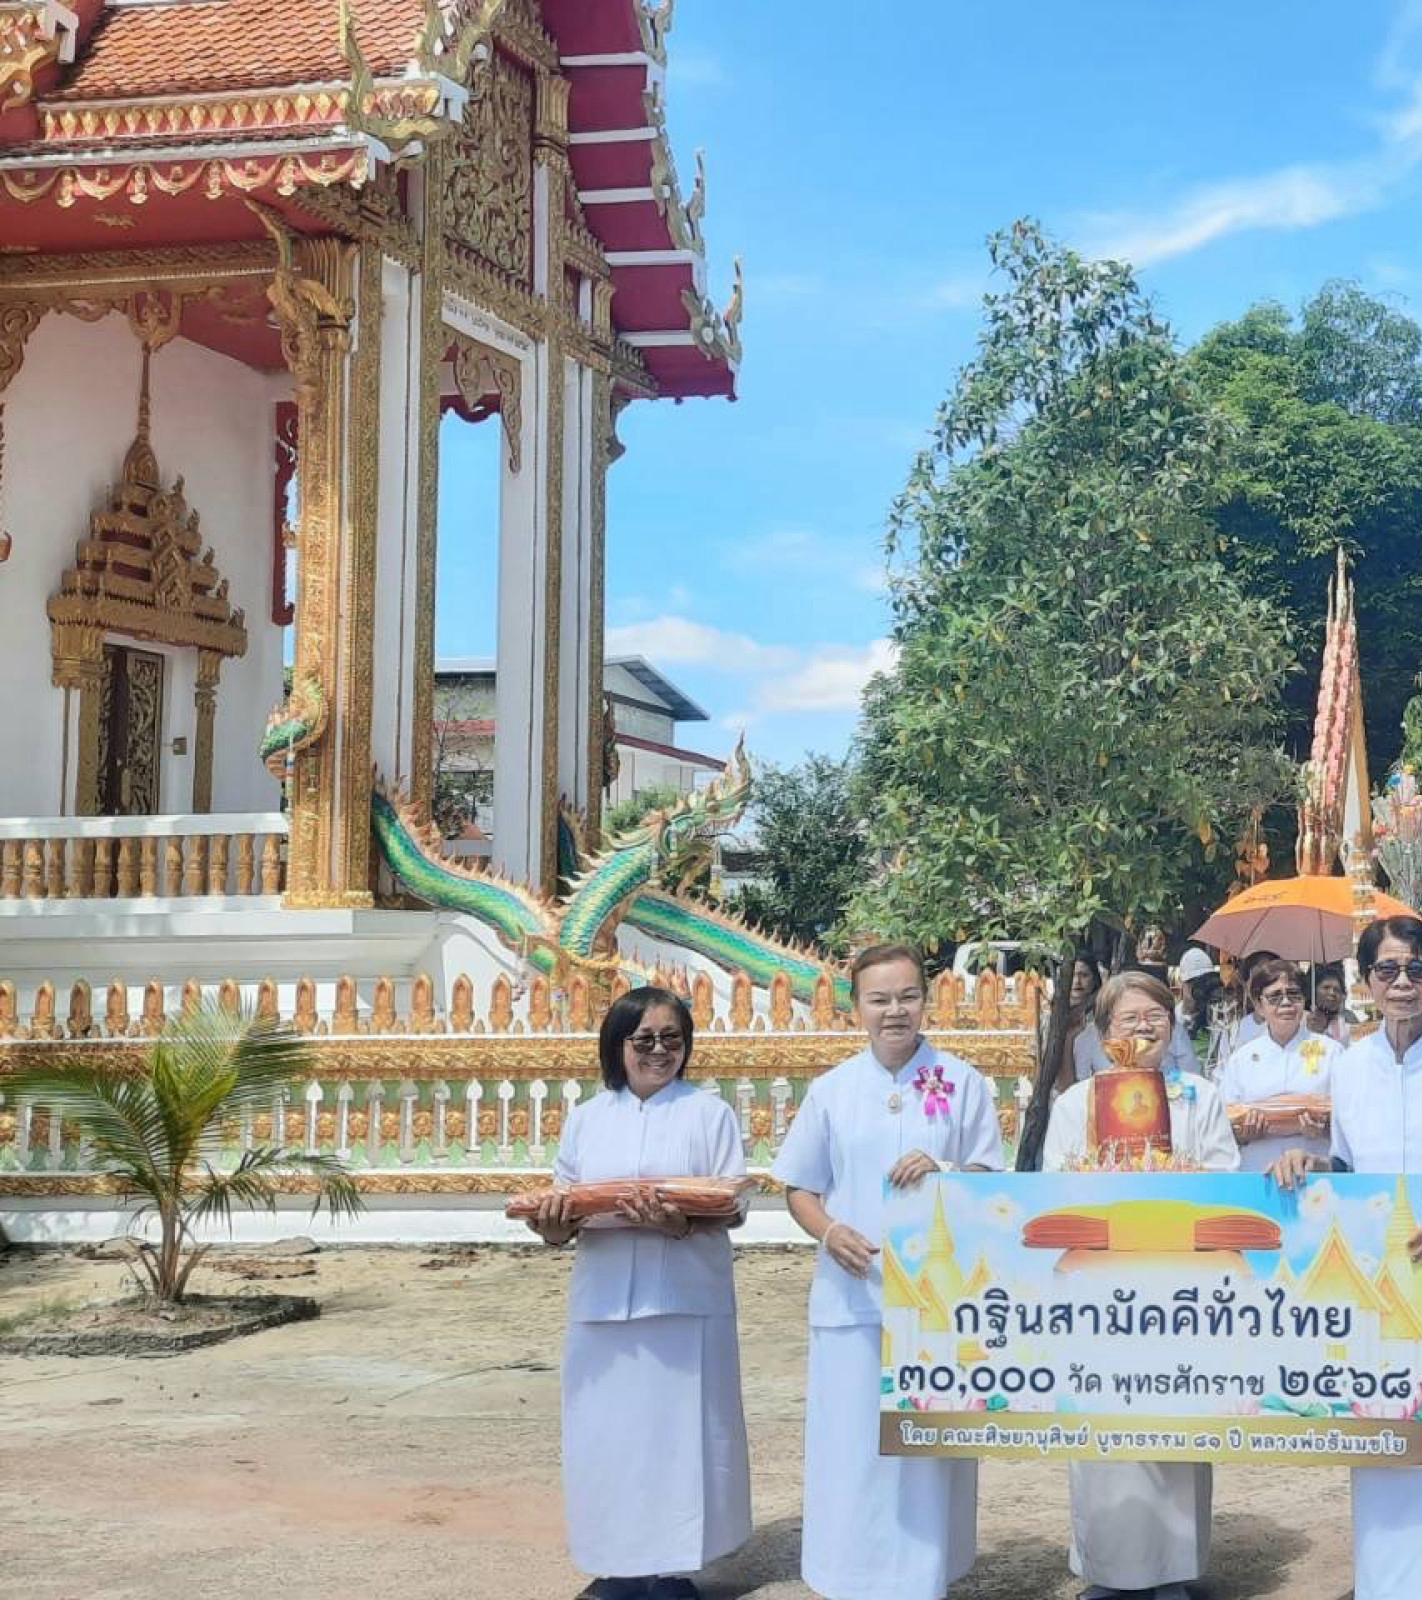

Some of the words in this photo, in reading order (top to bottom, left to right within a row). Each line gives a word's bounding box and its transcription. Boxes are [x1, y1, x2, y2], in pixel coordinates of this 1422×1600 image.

[954, 1275, 1352, 1349] กฐินสามัคคีทั่วไทย
[899, 1364, 1056, 1397] ๓๐,๐๐๐
[1068, 1362, 1102, 1394] วัด
[1112, 1363, 1265, 1405] พุทธศักราช
[1279, 1364, 1412, 1400] ๒๕๖๘
[900, 1420, 937, 1447] โดย
[1095, 1429, 1187, 1455] บูชาธรรม
[1228, 1426, 1244, 1450] ปี
